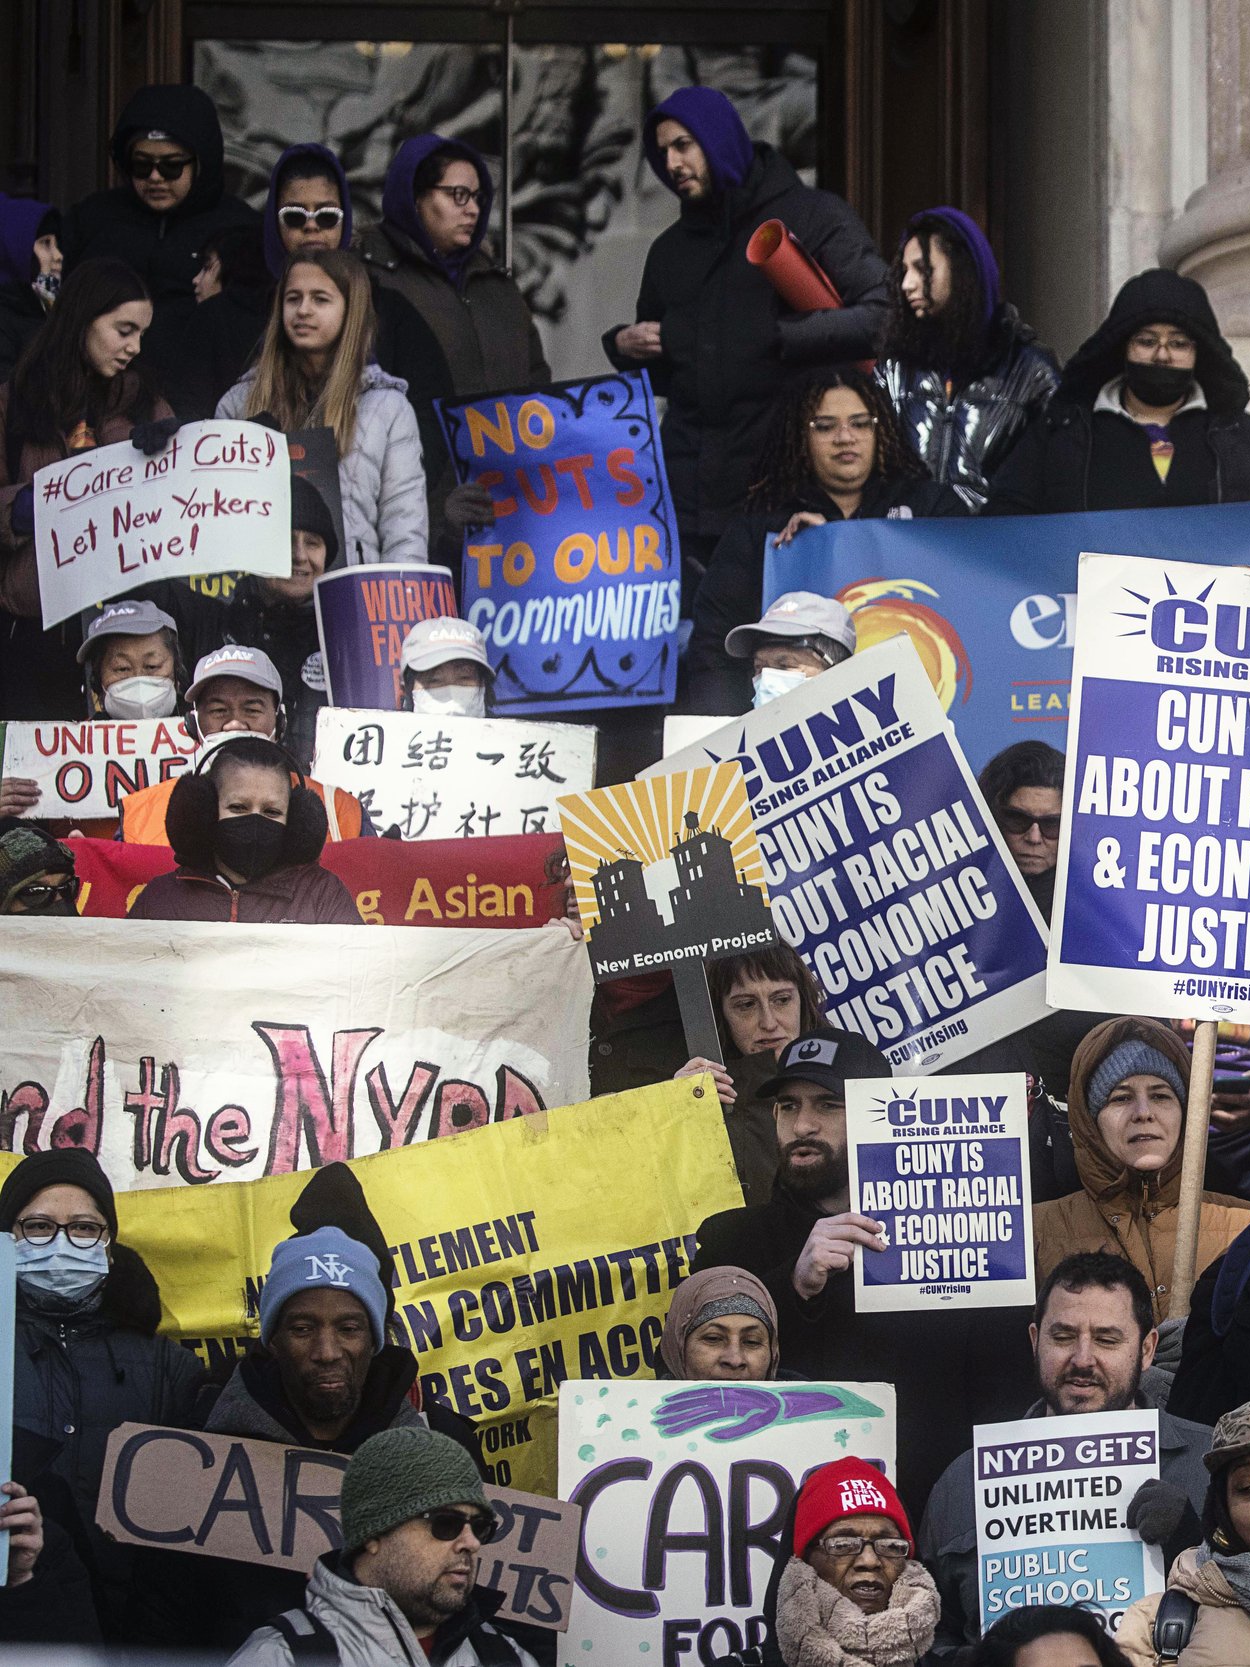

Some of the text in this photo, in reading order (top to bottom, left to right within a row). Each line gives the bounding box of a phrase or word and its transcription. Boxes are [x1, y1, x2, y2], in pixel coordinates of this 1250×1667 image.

[465, 400, 555, 457] NO
[43, 432, 276, 503] #Care not Cuts!
[476, 447, 645, 518] CUTS
[51, 487, 272, 569] Let New Yorkers
[117, 522, 200, 574] Live!
[467, 524, 664, 589] TO OUR
[361, 580, 458, 622] WORKIN
[1156, 654, 1249, 682] RISING
[1011, 693, 1072, 711] LEA
[35, 722, 201, 757] UNITE AS
[343, 723, 567, 785] 团结一致
[750, 721, 916, 821] ISING ALLIANCE
[1077, 754, 1231, 828] ABOUT
[757, 770, 903, 886] CUNY IS
[770, 799, 990, 949] OUT RACIAL
[1092, 836, 1126, 890] &
[404, 872, 534, 921] Asian
[596, 927, 773, 976] New Economy Project
[825, 942, 988, 1052] JUSTICE
[123, 1055, 259, 1184] the
[886, 1096, 1009, 1127] CUNY
[892, 1124, 1006, 1138] RISING ALLIANCE
[895, 1141, 984, 1177] CUNY IS
[862, 1175, 1021, 1212] ABOUT RACIAL
[895, 1210, 1013, 1247] ECONOMIC
[304, 1252, 355, 1288] NY
[900, 1247, 990, 1281] JUSTICE
[919, 1284, 971, 1295] #CUNYrising
[514, 1340, 568, 1402] EN
[983, 1435, 1153, 1475] NYPD GETS
[112, 1429, 354, 1557] CAR
[837, 1479, 877, 1491] TAX
[840, 1489, 887, 1511] RICH
[983, 1475, 1123, 1509] UNLIMITED
[569, 1455, 887, 1619] CAR
[984, 1507, 1127, 1540] OVERTIME.
[985, 1548, 1089, 1583] PUBLIC
[987, 1576, 1132, 1613] SCHOOLS
